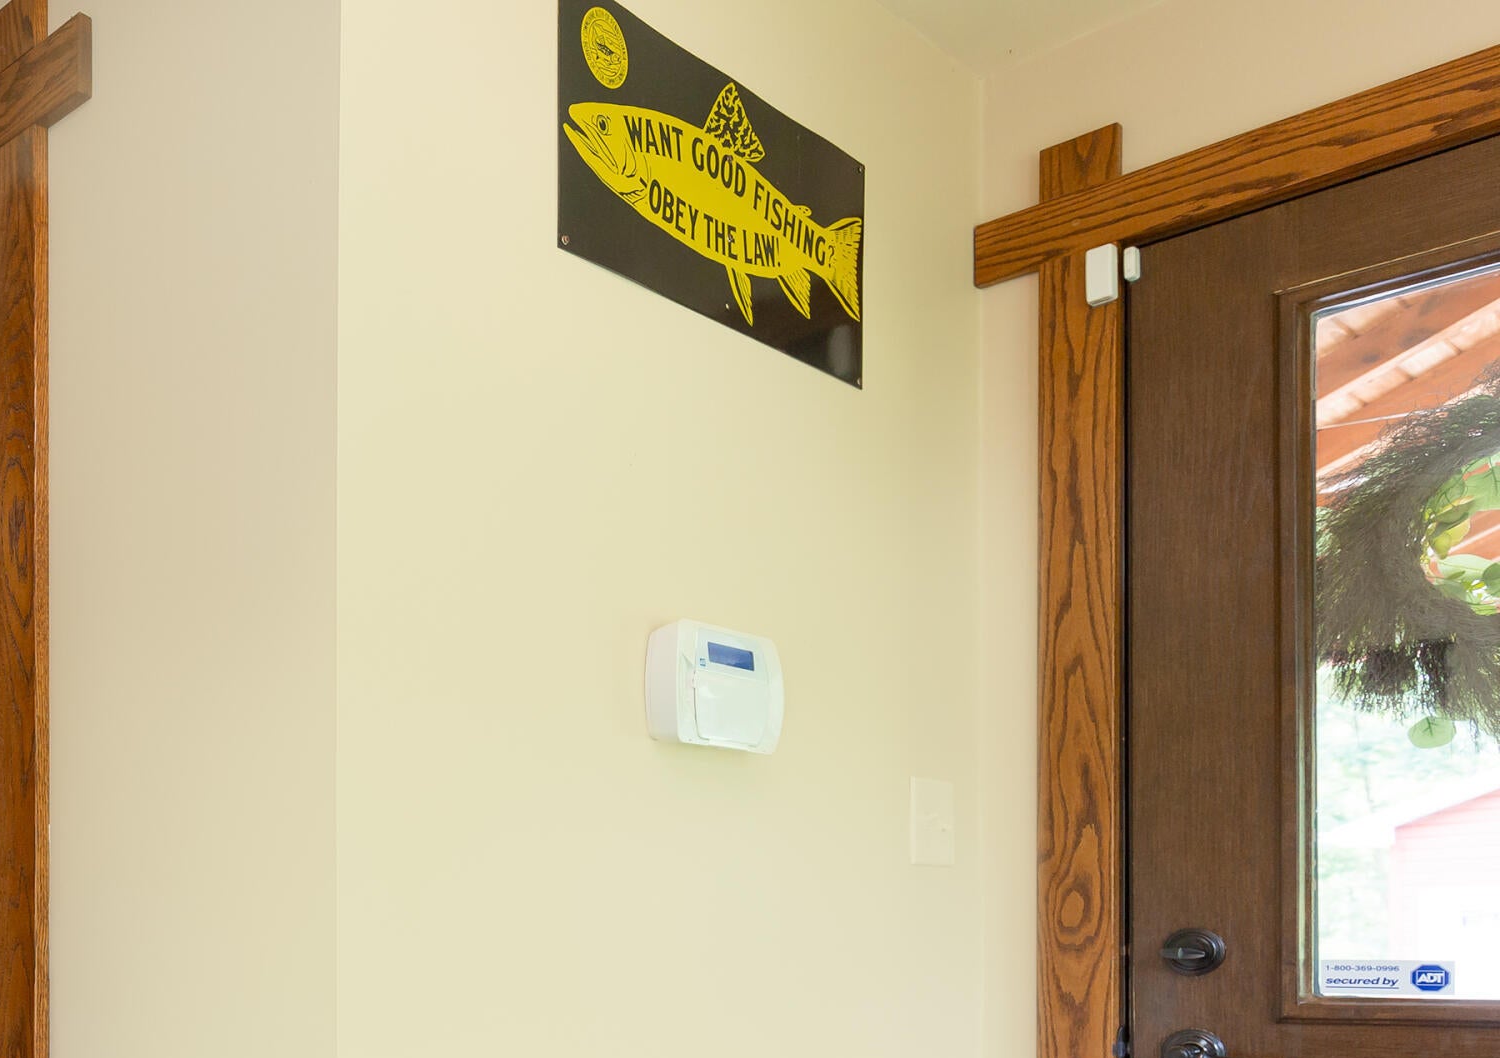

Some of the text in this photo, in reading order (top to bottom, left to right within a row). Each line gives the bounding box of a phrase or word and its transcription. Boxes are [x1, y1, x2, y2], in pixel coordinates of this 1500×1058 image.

[623, 115, 835, 268] WANT GOOD FISHING?
[703, 213, 738, 260] THE
[742, 229, 781, 267] LAW!
[1325, 976, 1400, 987] secured by
[1417, 972, 1445, 984] ADT
